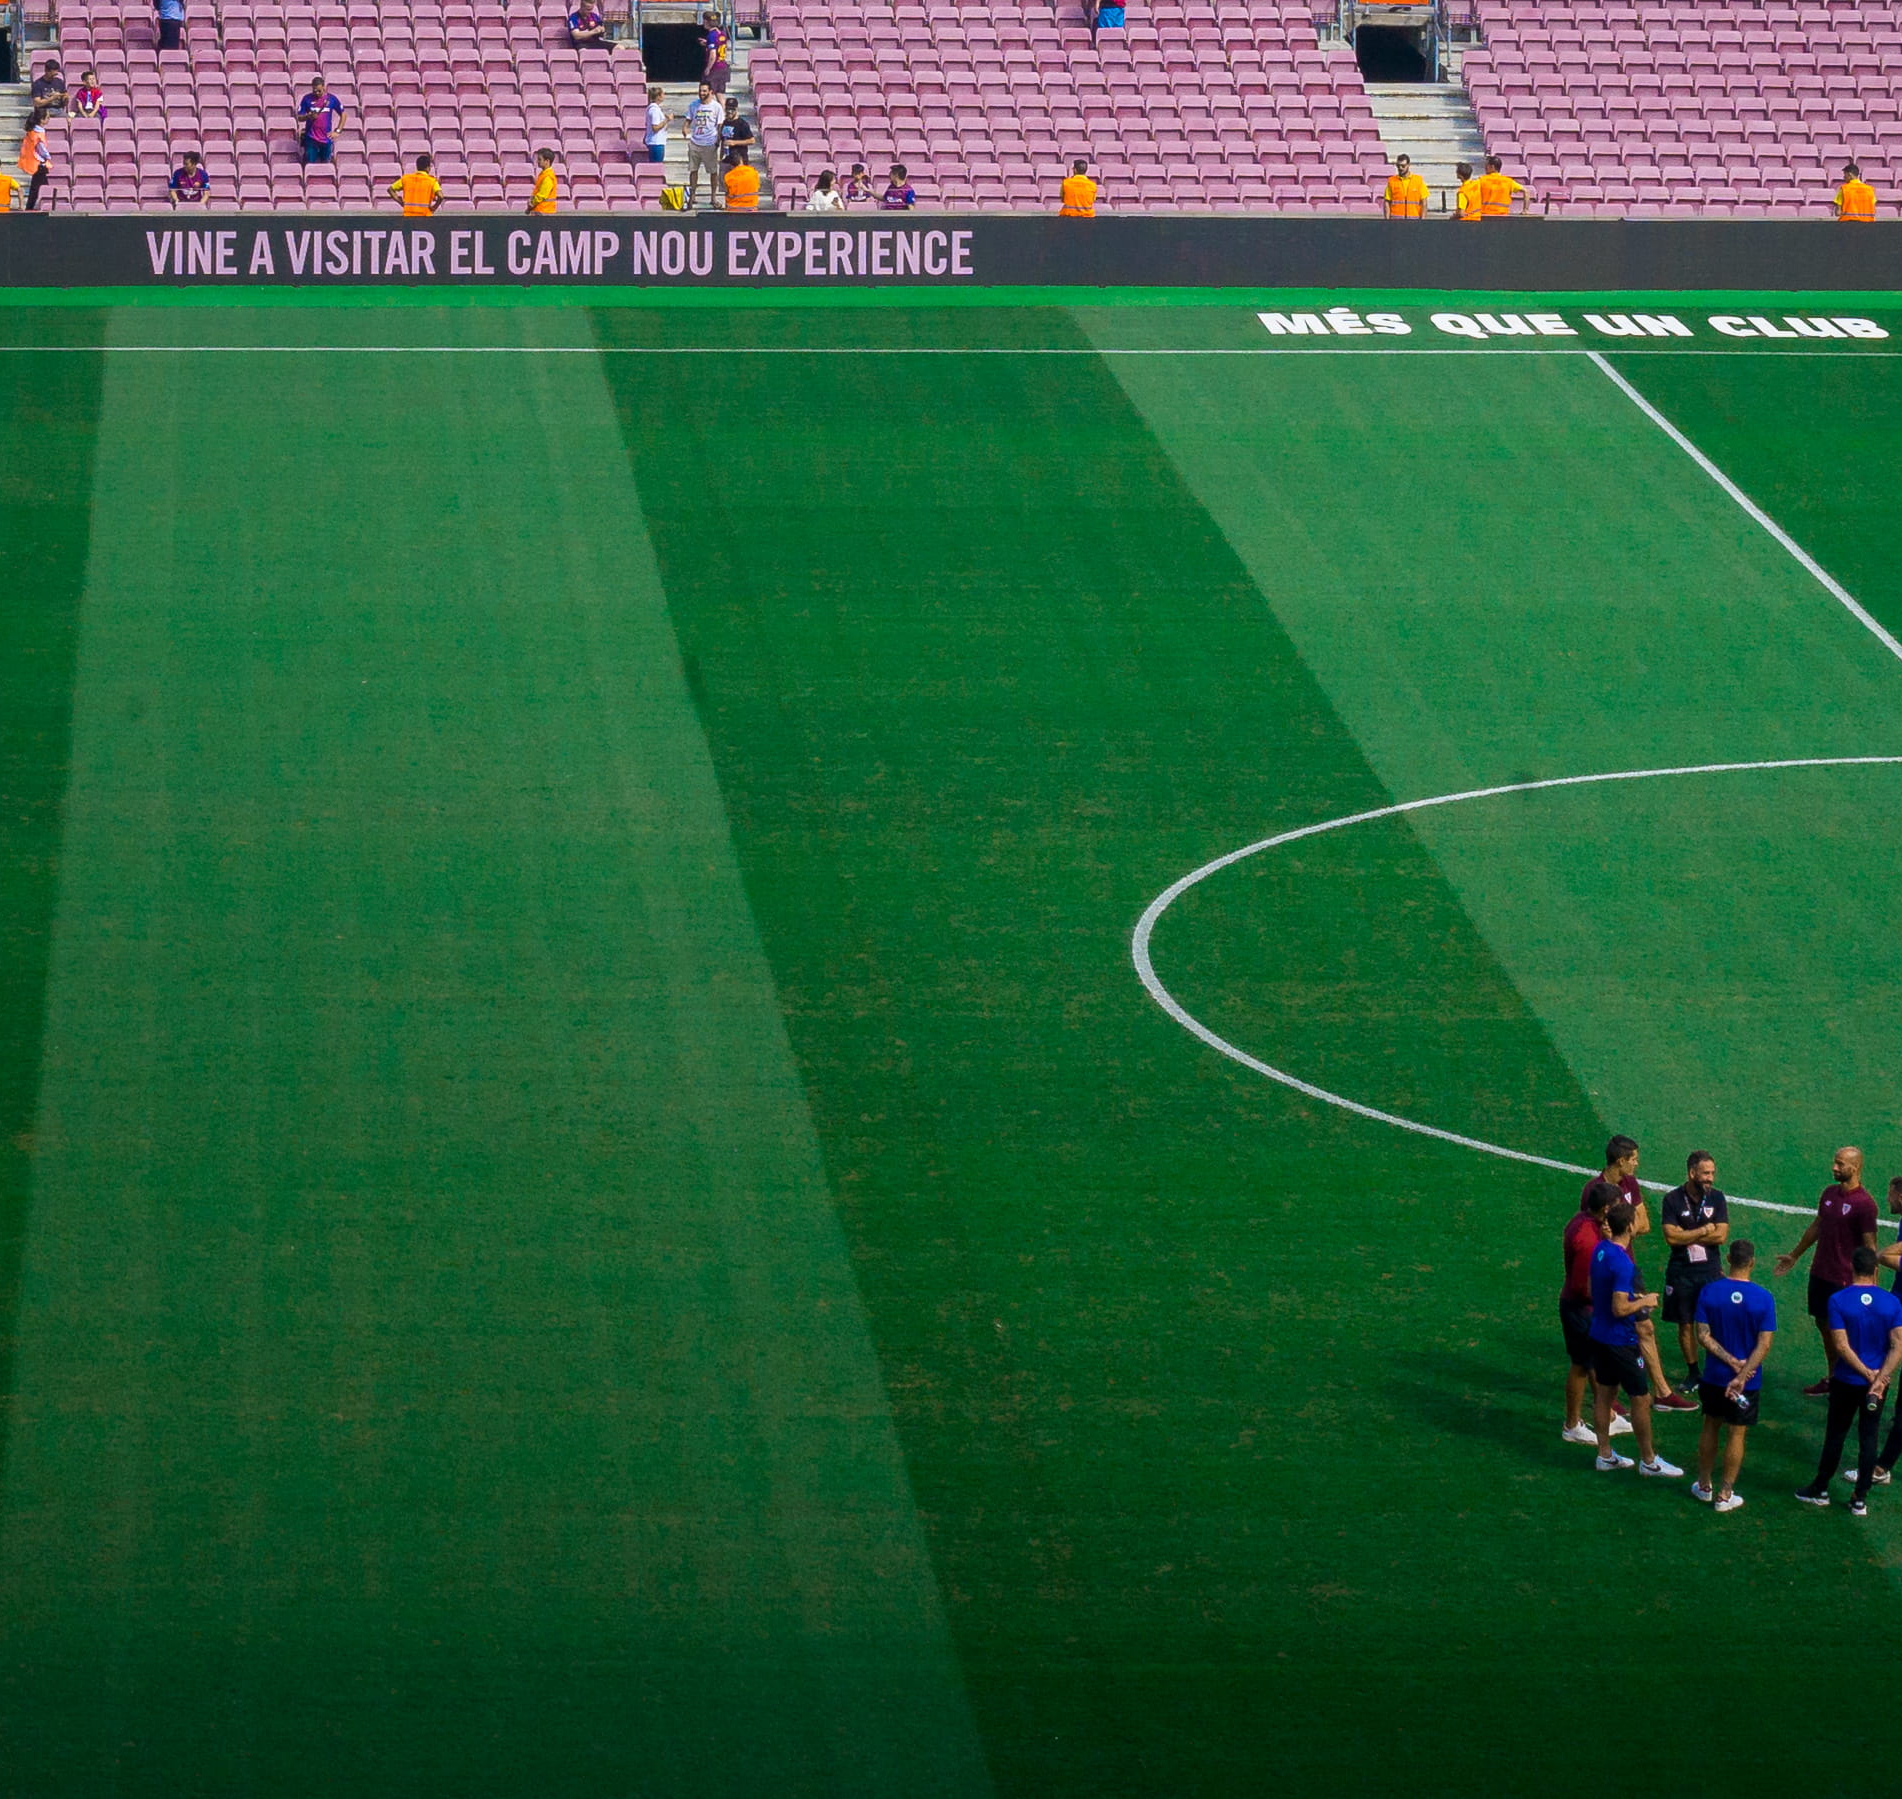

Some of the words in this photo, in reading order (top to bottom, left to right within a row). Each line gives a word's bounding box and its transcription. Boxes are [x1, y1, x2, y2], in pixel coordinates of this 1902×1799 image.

[145, 230, 238, 275] VINE
[248, 230, 275, 275] A
[284, 229, 437, 276] VISITAR
[449, 230, 495, 275] EL
[507, 229, 620, 276] CAMP
[633, 230, 714, 277] NOU
[727, 229, 974, 276] EXPERIENCE
[1256, 307, 1412, 335] MÉS
[1429, 313, 1579, 340] QUE
[1582, 313, 1695, 338] UN
[1706, 315, 1891, 340] CLUB
